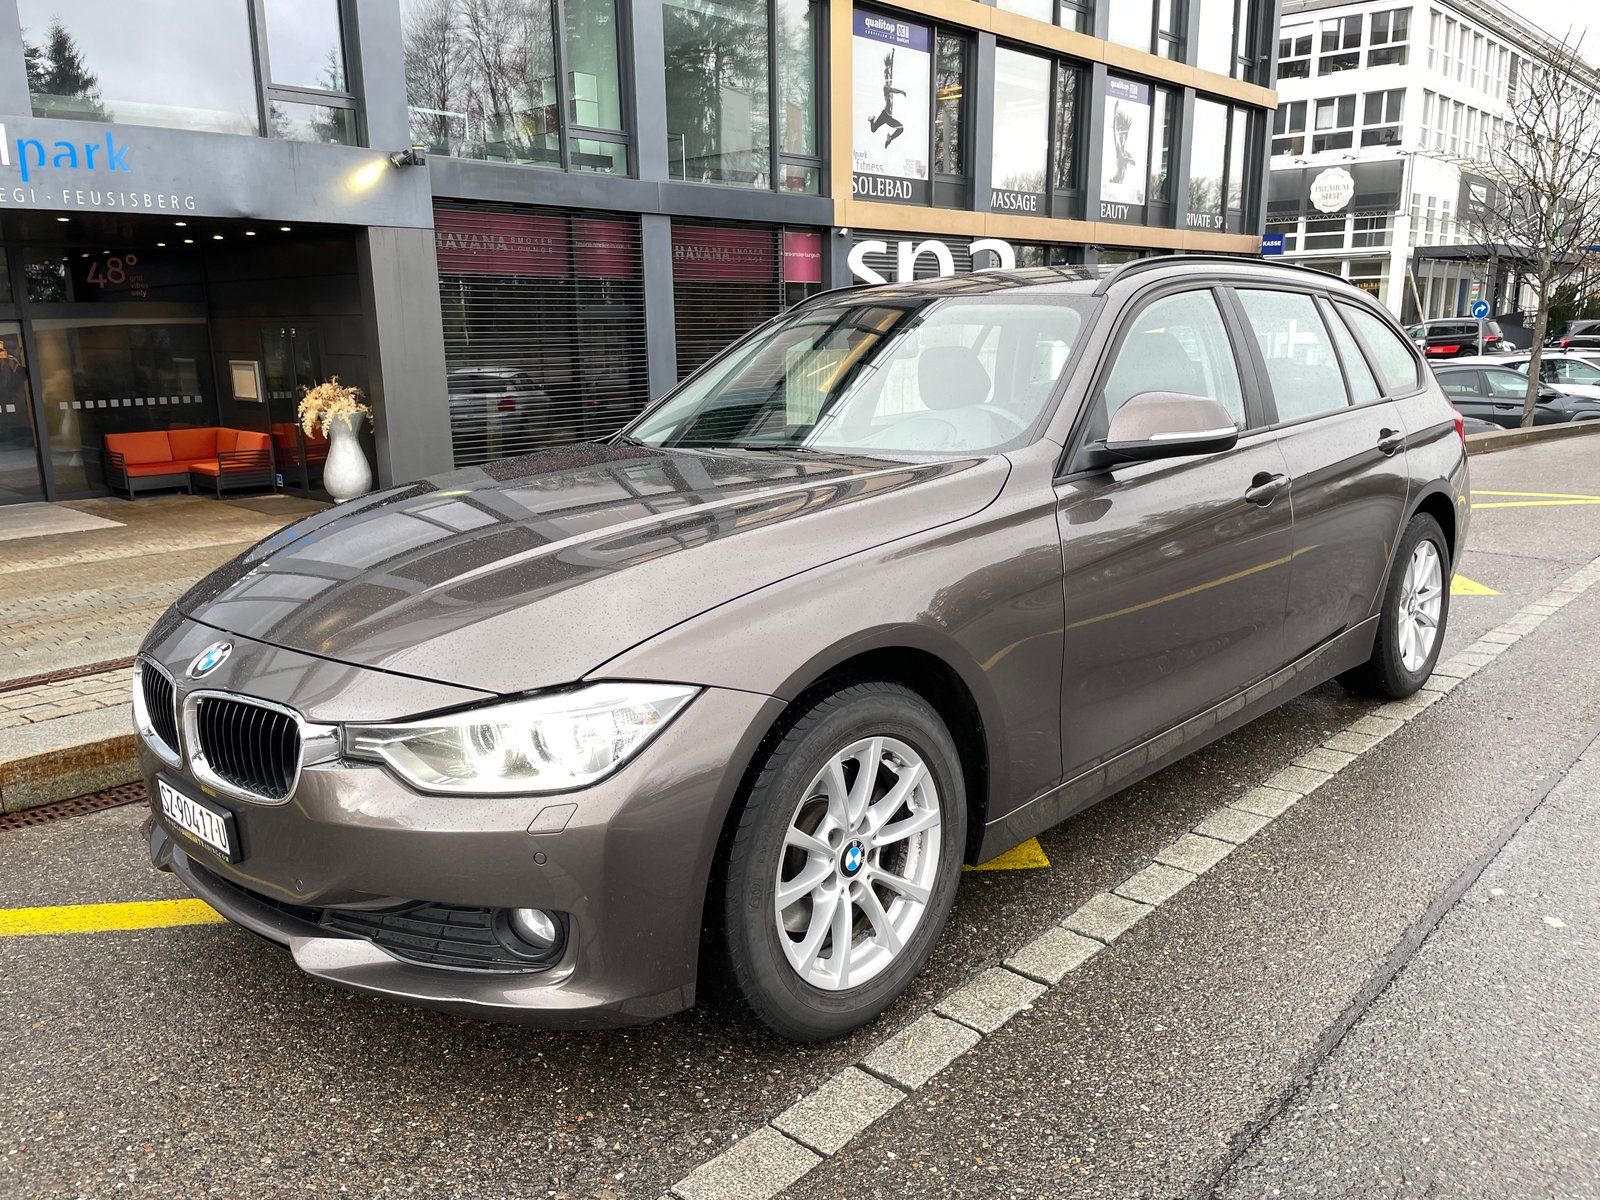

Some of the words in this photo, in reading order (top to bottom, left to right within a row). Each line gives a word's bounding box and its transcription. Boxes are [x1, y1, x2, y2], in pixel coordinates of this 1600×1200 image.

[865, 17, 896, 34] qualitop
[856, 159, 884, 174] fitness
[852, 175, 912, 199] SOLEBAD
[63, 189, 196, 210] FEUSISBERG
[675, 245, 731, 262] HAVANA
[131, 289, 148, 298] only
